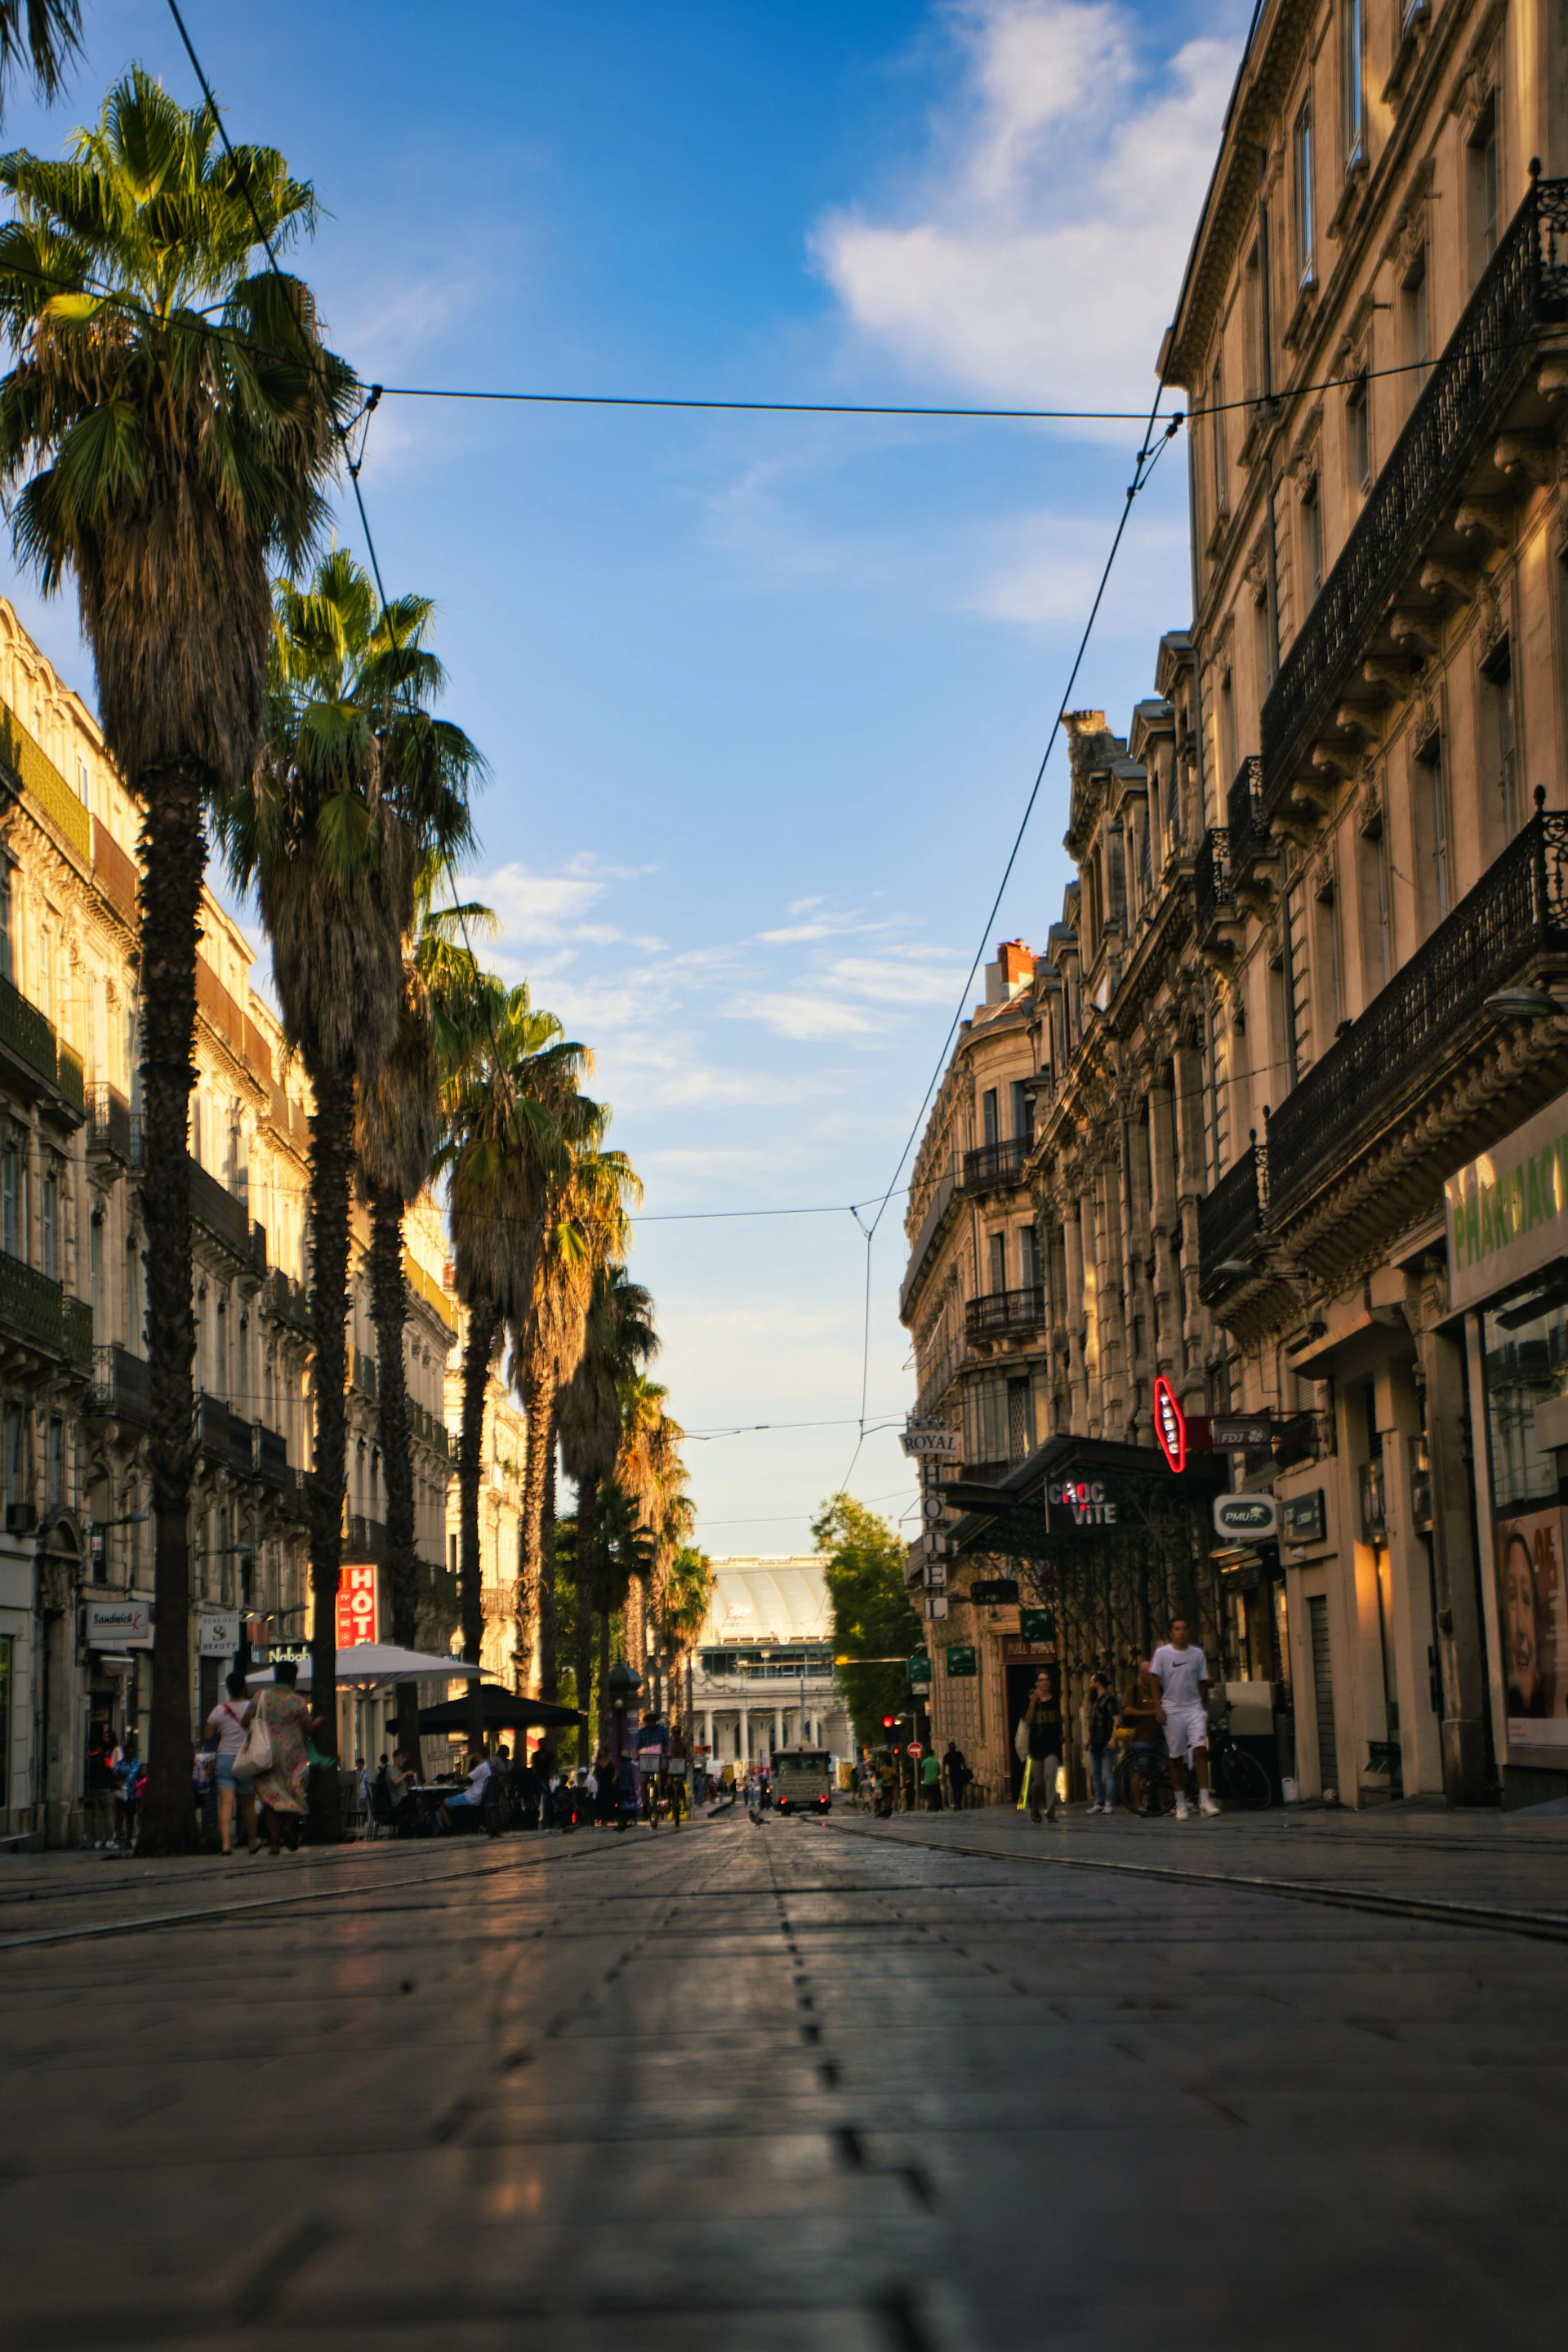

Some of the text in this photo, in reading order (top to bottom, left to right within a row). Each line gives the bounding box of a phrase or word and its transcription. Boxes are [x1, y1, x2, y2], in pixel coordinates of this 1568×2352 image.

[904, 1435, 957, 1451] ROYAL
[1221, 1433, 1243, 1443] FDJ
[1225, 1512, 1250, 1521] PMU
[923, 1465, 946, 1620] HOTEL
[350, 1570, 372, 1646] HÔT
[93, 1612, 132, 1624] Sandwich
[203, 1616, 237, 1624] SENEGAL
[203, 1642, 237, 1650] BEAUTY
